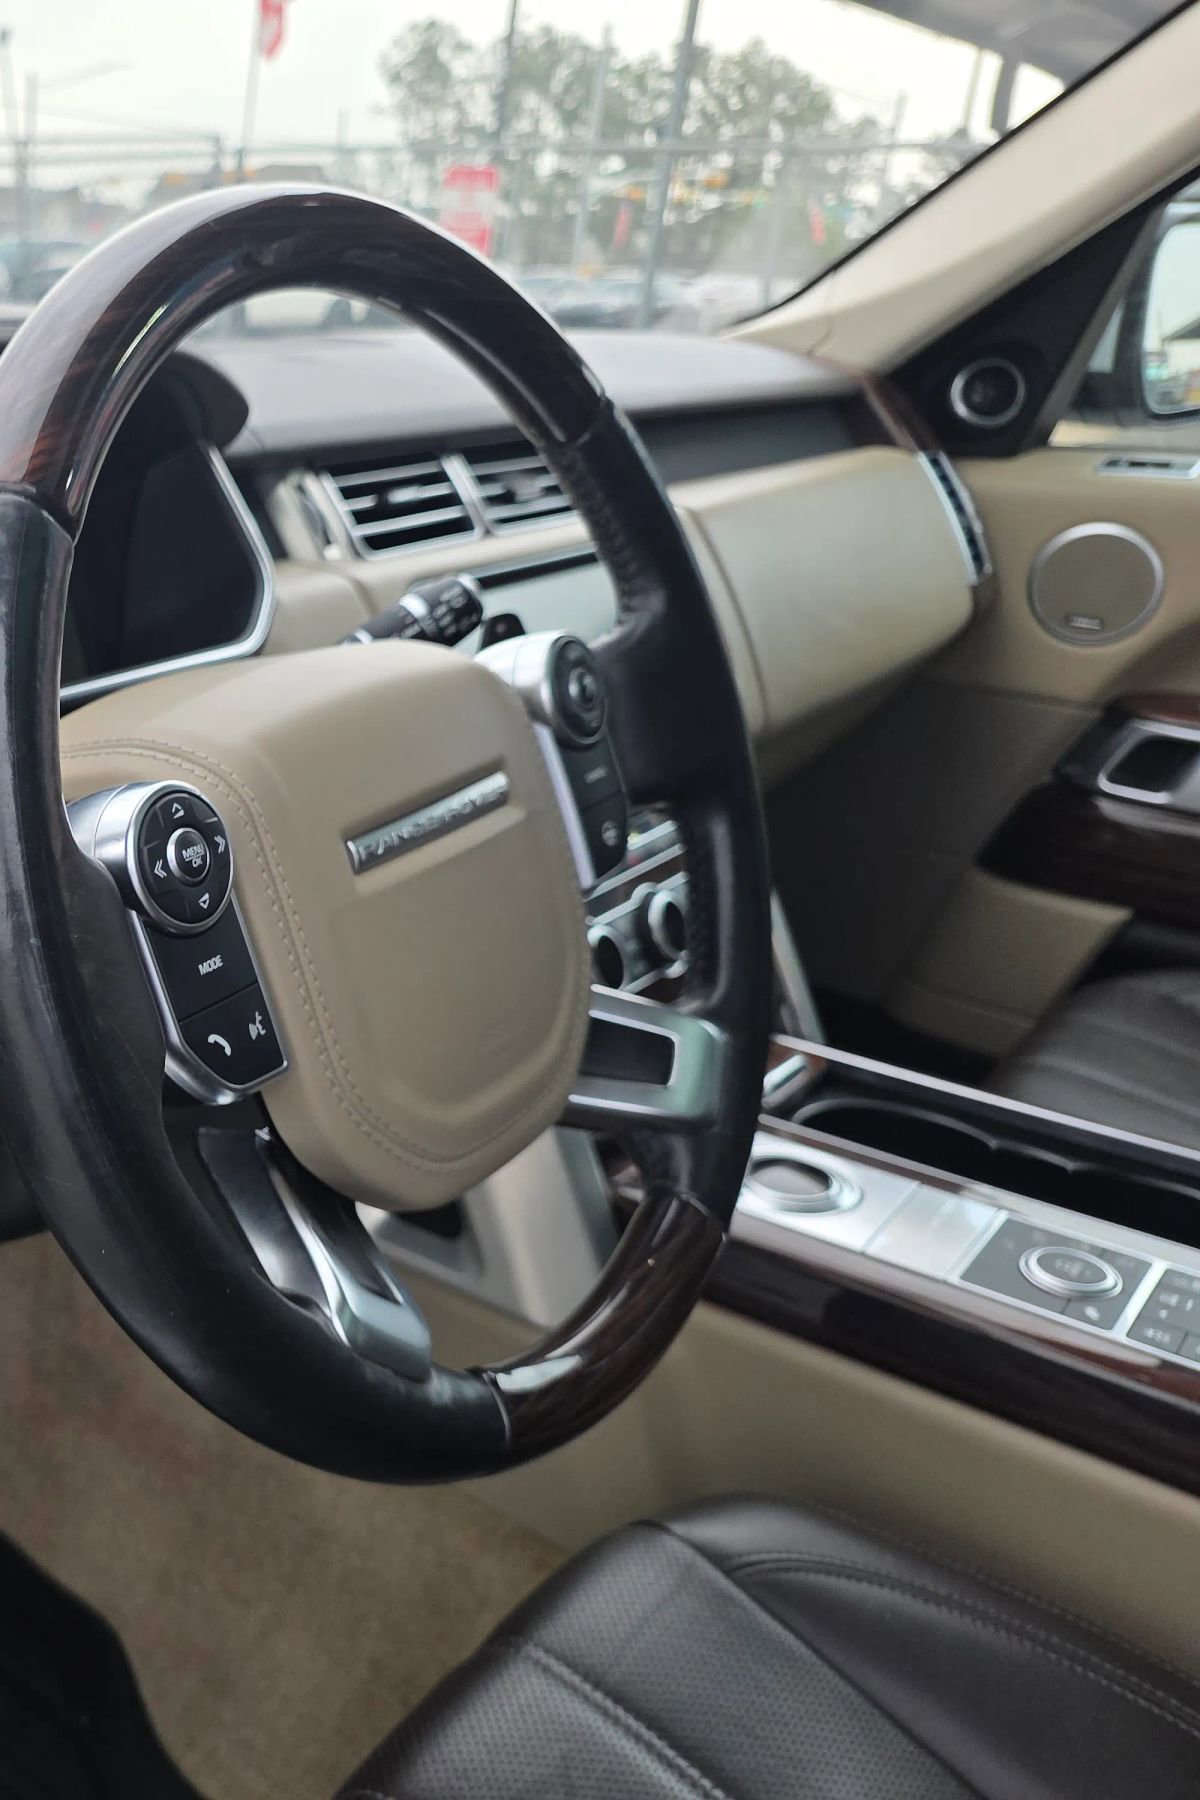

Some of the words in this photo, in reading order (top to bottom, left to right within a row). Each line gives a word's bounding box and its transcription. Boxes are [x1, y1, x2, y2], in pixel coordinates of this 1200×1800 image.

[182, 843, 204, 859] MENU
[192, 856, 203, 868] OK
[198, 954, 224, 976] MODE
